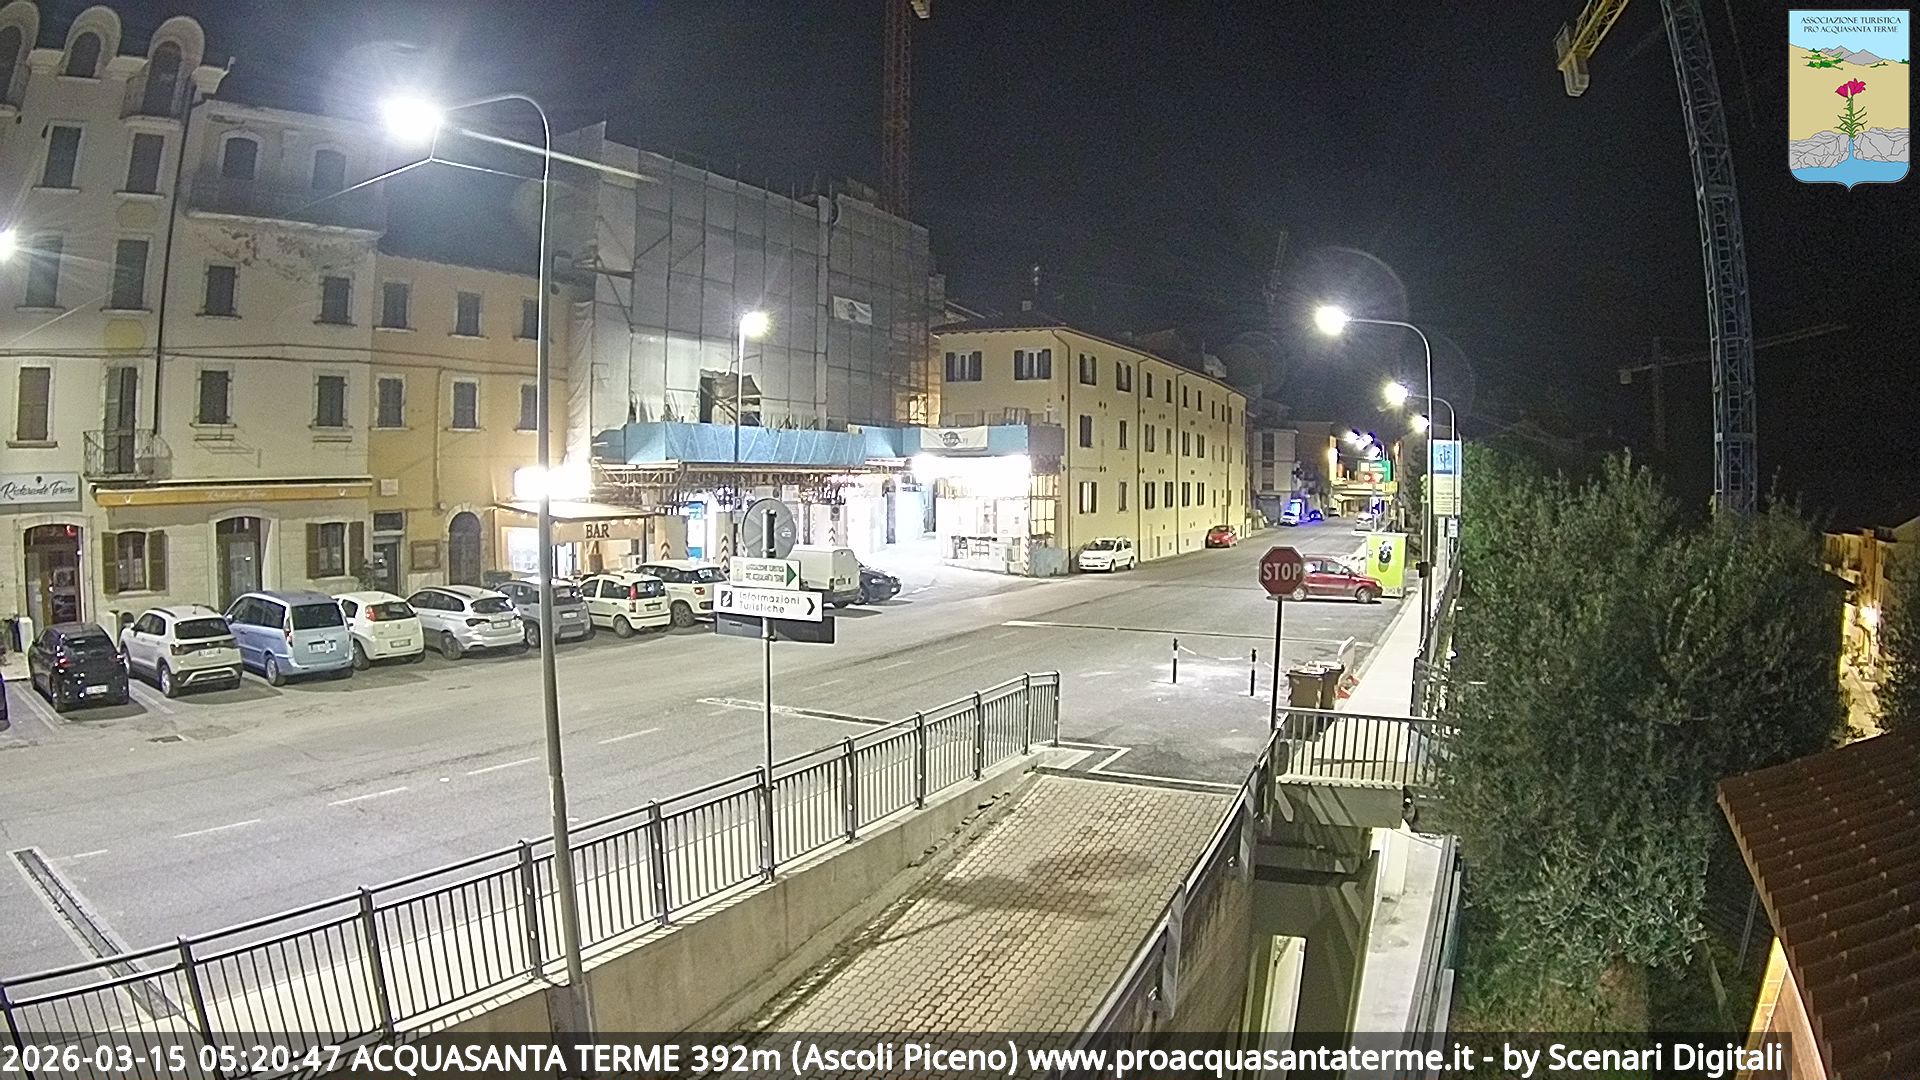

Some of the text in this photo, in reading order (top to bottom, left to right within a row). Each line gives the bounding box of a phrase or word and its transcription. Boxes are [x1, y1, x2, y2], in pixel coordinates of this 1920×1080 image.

[586, 523, 610, 539] BAR
[1263, 562, 1301, 581] STOP
[739, 591, 800, 605] Informazioni
